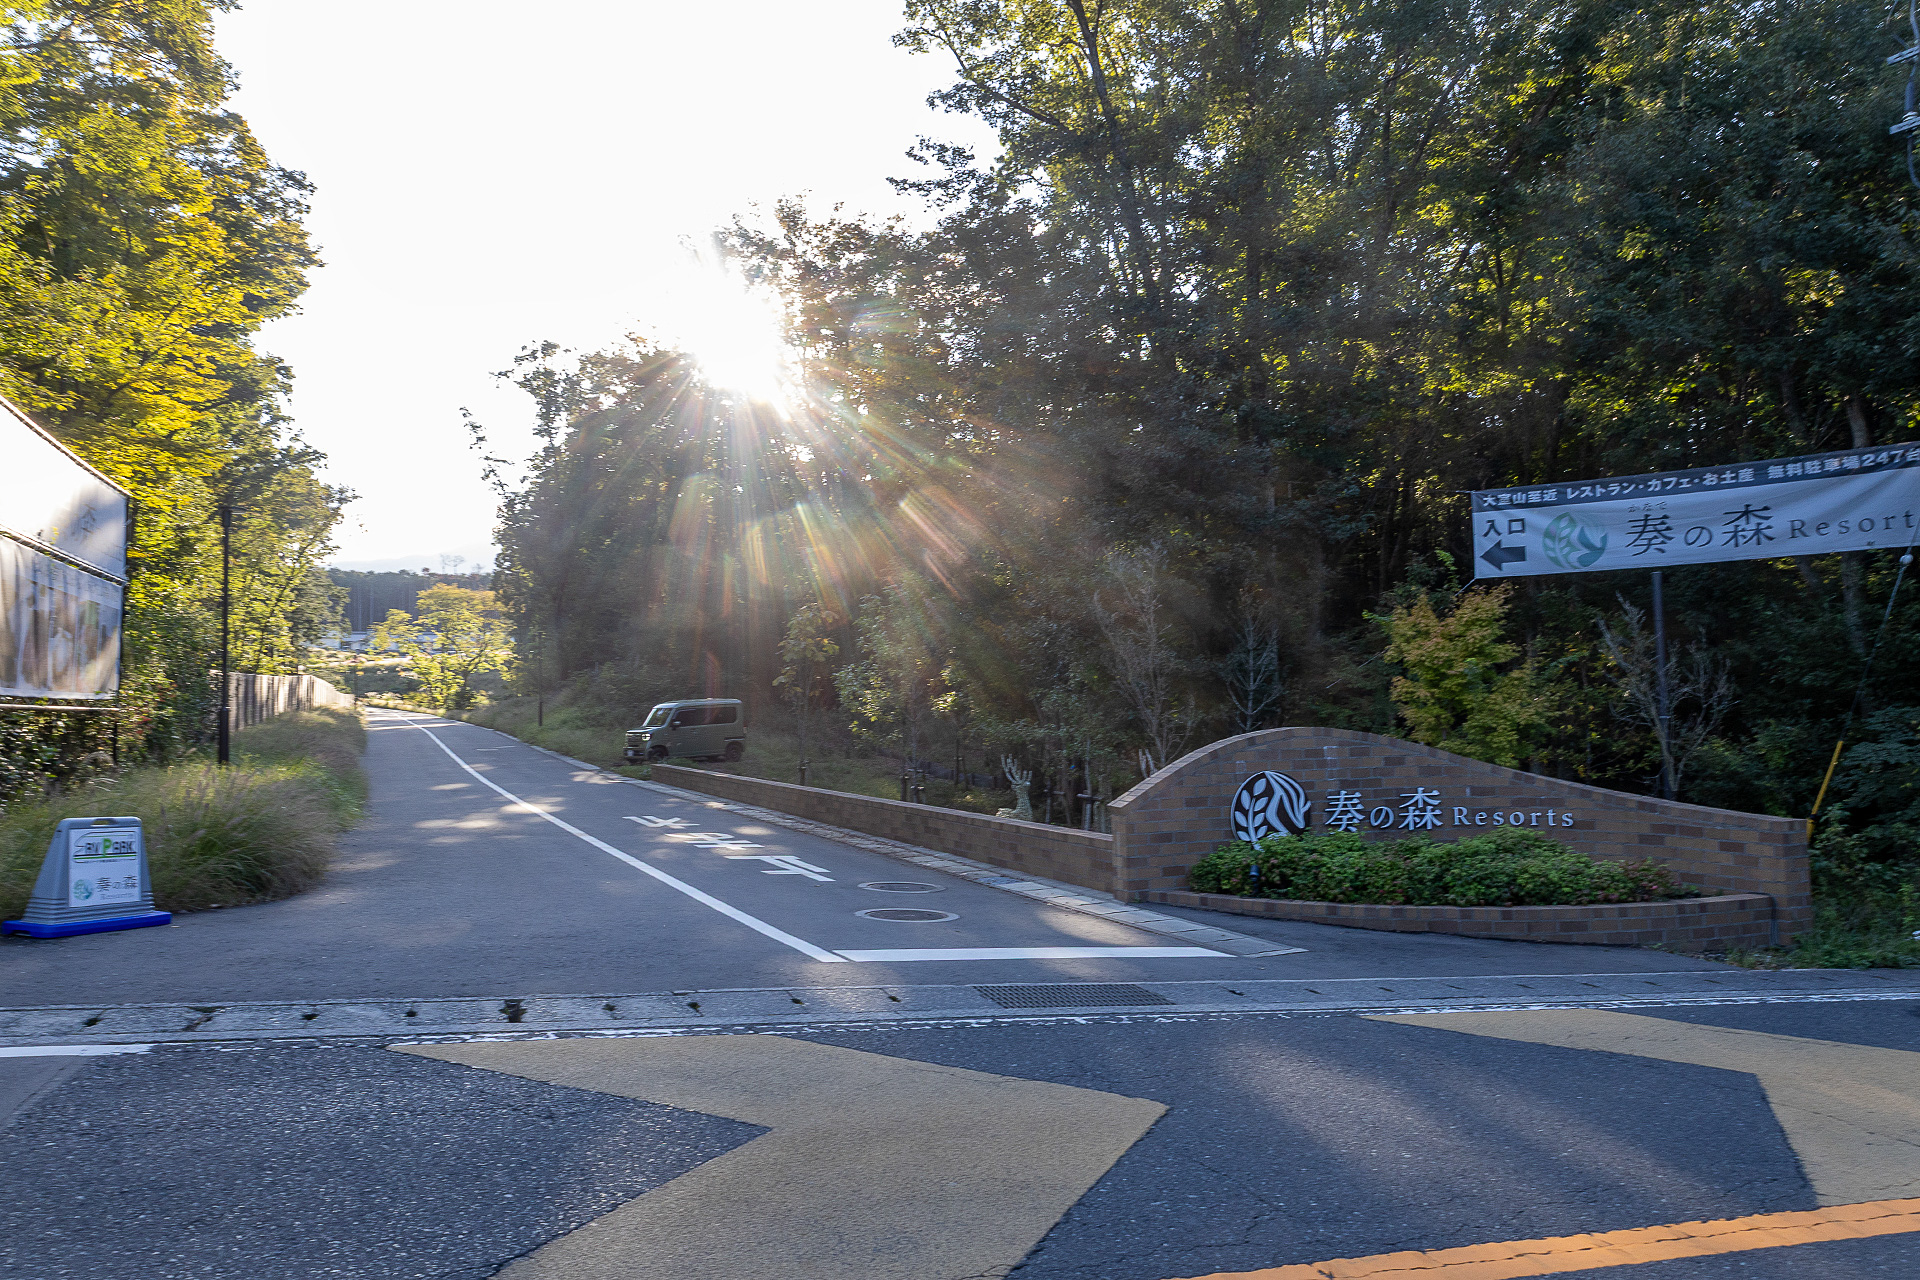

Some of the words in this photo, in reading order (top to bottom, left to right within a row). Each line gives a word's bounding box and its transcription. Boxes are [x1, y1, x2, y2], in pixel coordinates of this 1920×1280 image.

[1482, 517, 1527, 538] 入口
[1625, 504, 1777, 557] 奏の森
[1787, 509, 1917, 540] Resort
[1324, 786, 1444, 832] 奏の森
[1452, 806, 1575, 828] Resorts
